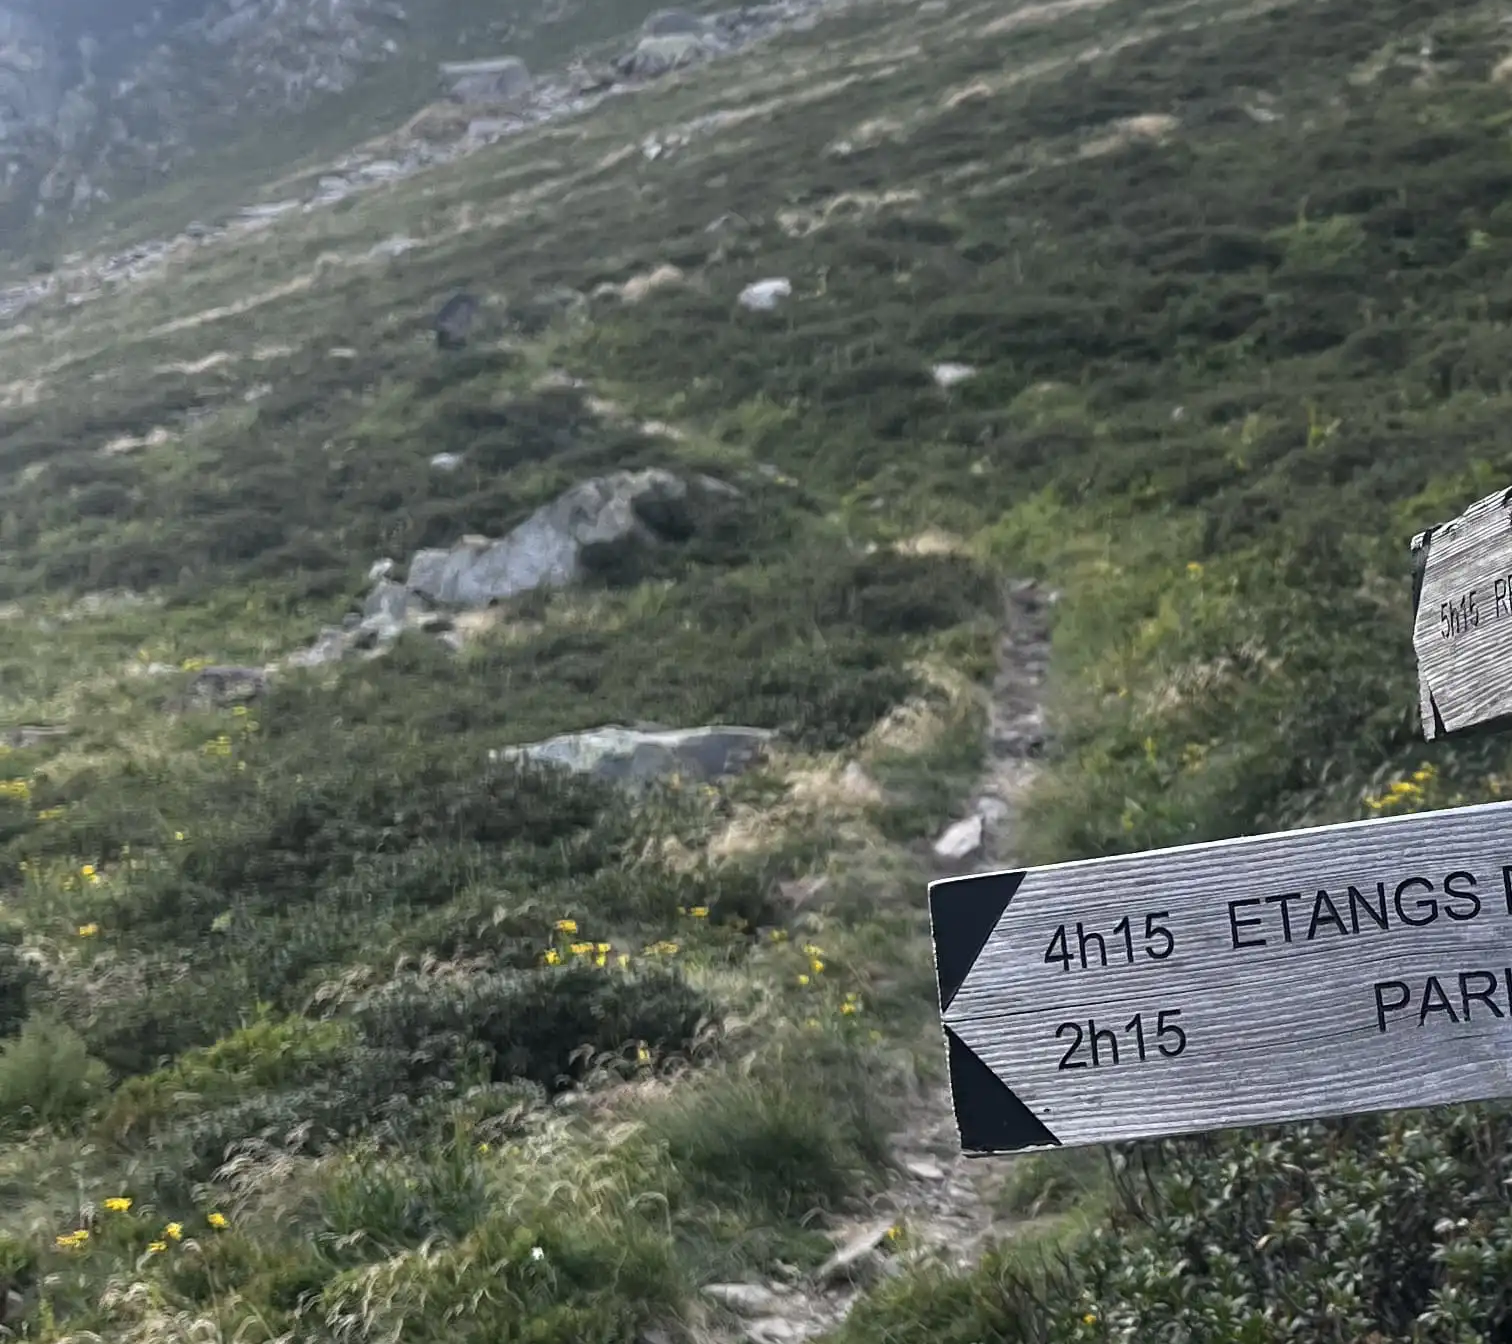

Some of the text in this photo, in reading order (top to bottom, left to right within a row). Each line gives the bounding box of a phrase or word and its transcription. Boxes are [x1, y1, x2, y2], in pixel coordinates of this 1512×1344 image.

[1440, 591, 1480, 639] 5h15
[1043, 912, 1175, 972] 4h15
[1229, 871, 1482, 950] ETANGS
[1055, 1009, 1187, 1070] 2h15
